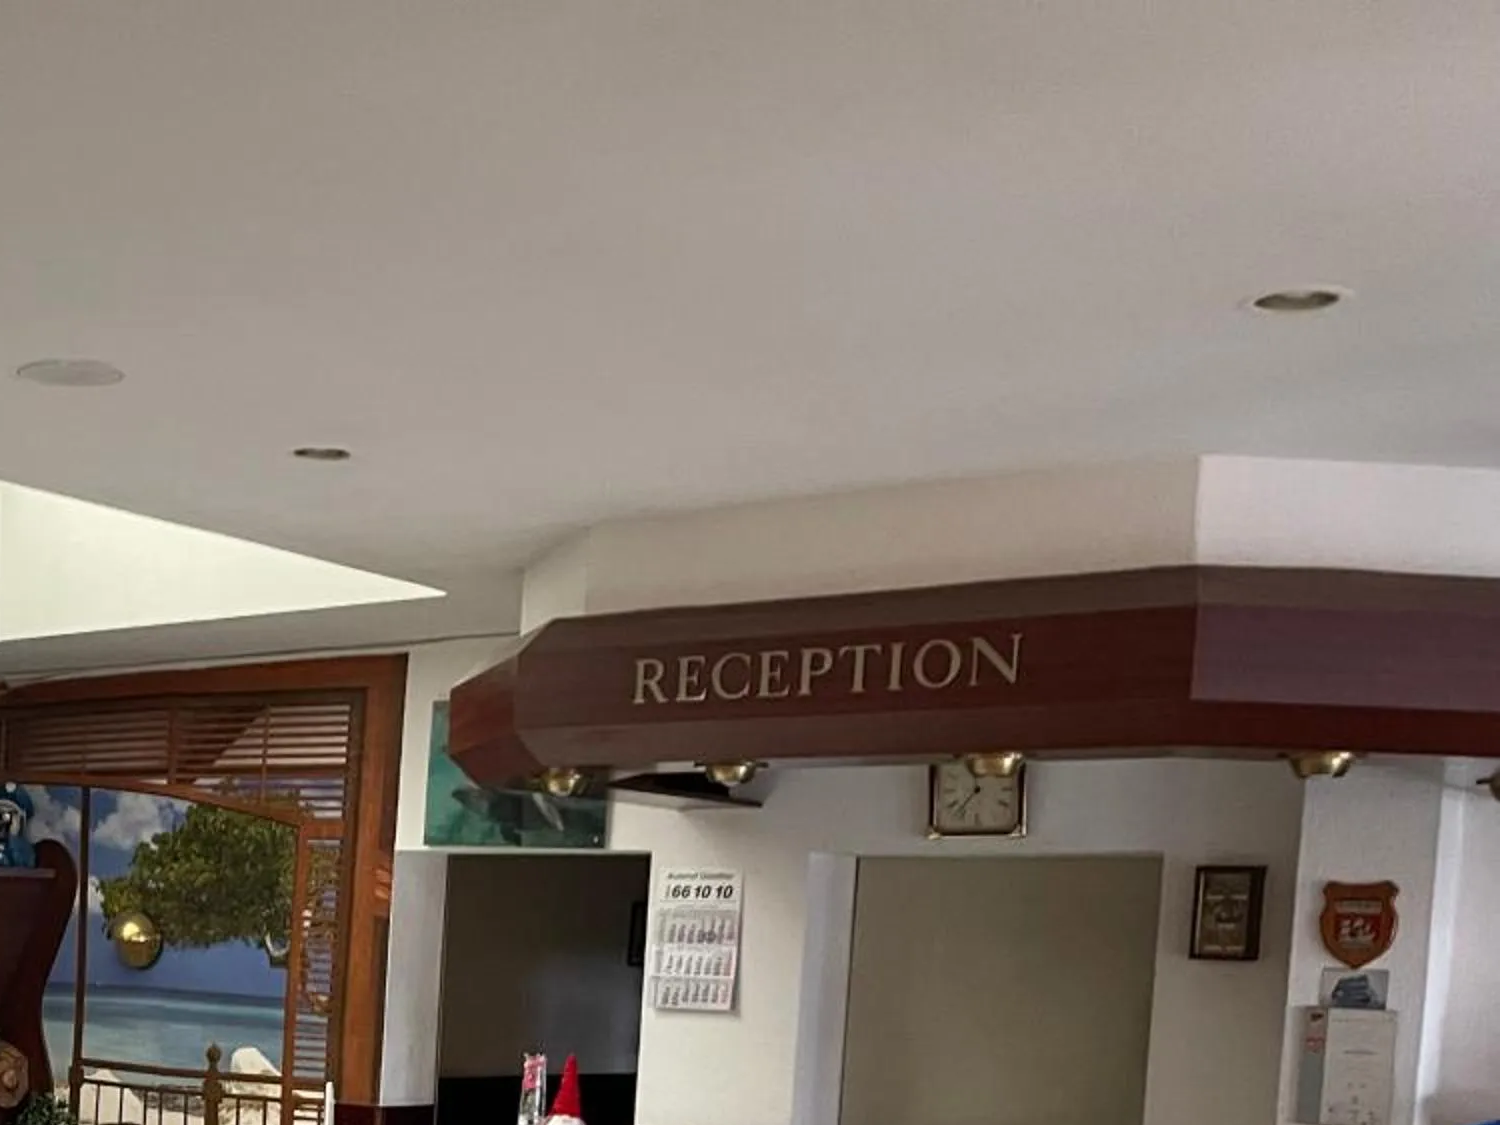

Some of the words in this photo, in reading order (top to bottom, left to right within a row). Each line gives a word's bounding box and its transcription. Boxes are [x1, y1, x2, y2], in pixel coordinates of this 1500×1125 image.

[632, 632, 1024, 705] RECEPTION
[672, 884, 692, 899] 66
[694, 884, 713, 899] 10
[716, 884, 734, 899] 10
